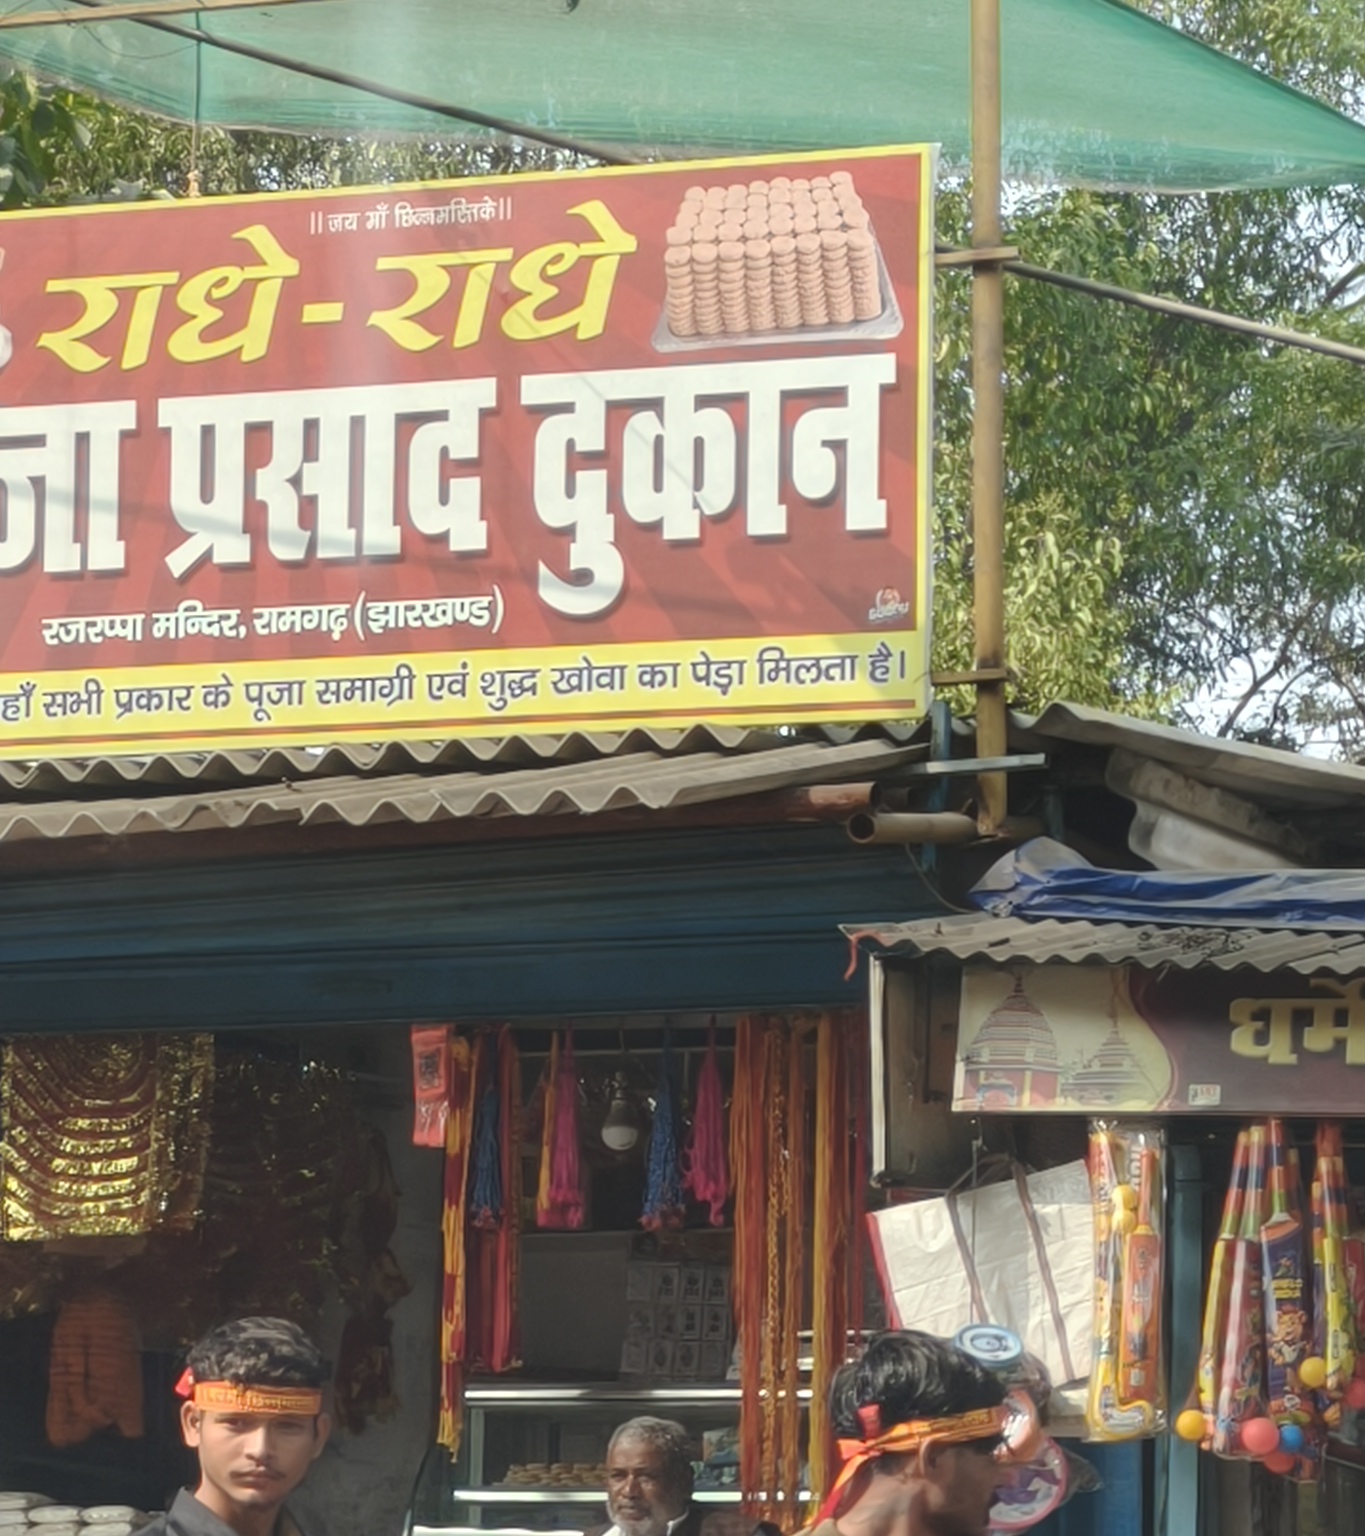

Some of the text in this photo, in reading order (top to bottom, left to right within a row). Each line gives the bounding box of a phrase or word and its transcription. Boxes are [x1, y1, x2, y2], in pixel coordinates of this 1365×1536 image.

[327, 213, 361, 233] जय
[364, 202, 389, 230] माँ
[0, 352, 897, 616] जा प्रसाद दुकान
[42, 583, 505, 646] रजरप्पा मन्दिर, रामगढ़ (झारखण्ड)
[0, 682, 36, 722] हाँ
[42, 678, 104, 718] सभी
[113, 685, 195, 719] प्रकार
[202, 673, 232, 710] के
[243, 680, 306, 722] पूजा
[427, 661, 469, 701] एवं
[480, 669, 541, 711] शुद्ध
[551, 656, 628, 695] खोवा
[638, 662, 680, 690] का
[691, 651, 746, 696] पेड़ा
[757, 647, 859, 686] मिलता
